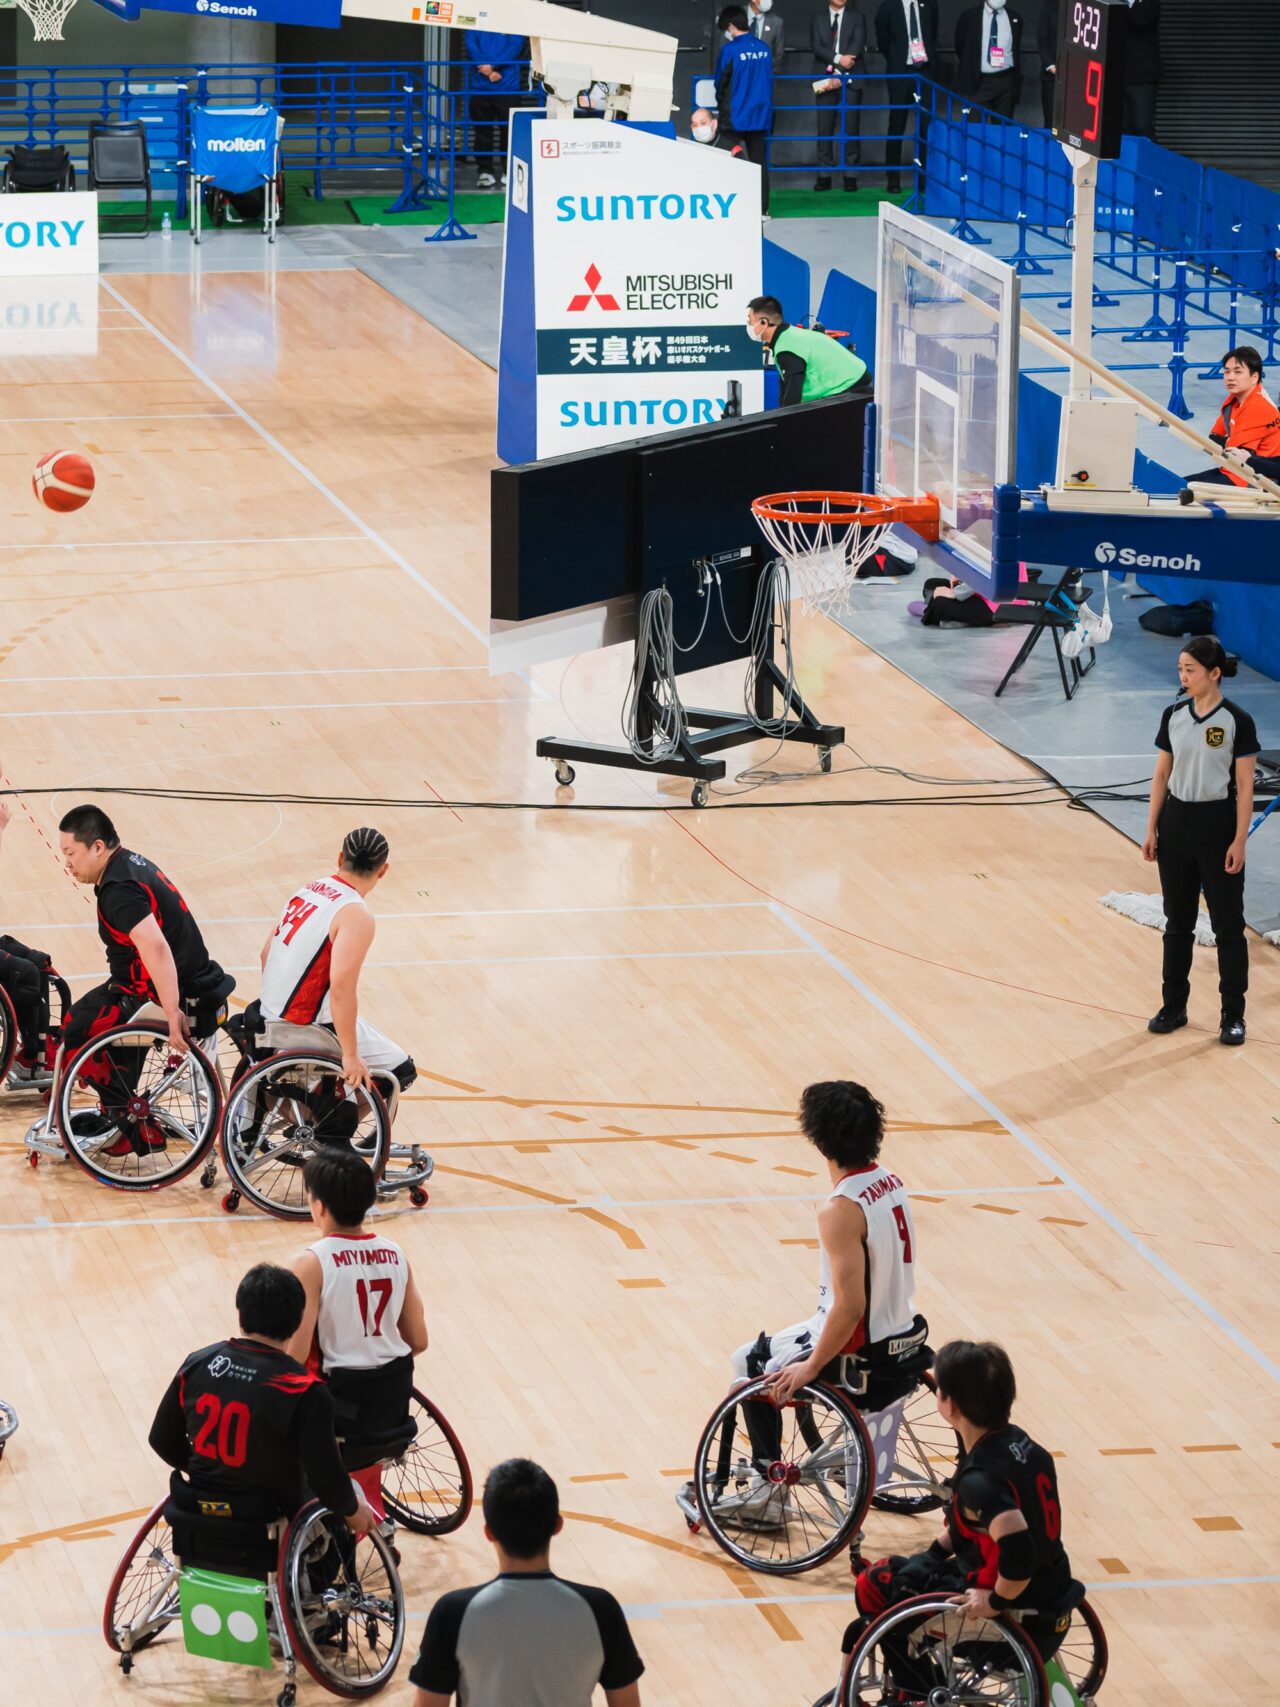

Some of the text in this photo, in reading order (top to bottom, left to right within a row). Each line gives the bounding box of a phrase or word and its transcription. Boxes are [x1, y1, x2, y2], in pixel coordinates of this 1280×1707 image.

[209, 2, 257, 17] Senoh
[1073, 2, 1101, 50] 9:23
[740, 51, 768, 61] STAFF
[1083, 60, 1103, 142] 9
[207, 137, 266, 152] molten
[626, 273, 733, 292] MITSUBISHI
[626, 293, 719, 311] ELECTRIC
[569, 335, 662, 366] 天皇杯
[1118, 548, 1201, 571] Senoh
[356, 1278, 393, 1337] 17
[194, 1392, 251, 1468] 20
[1036, 1472, 1061, 1540] 6
